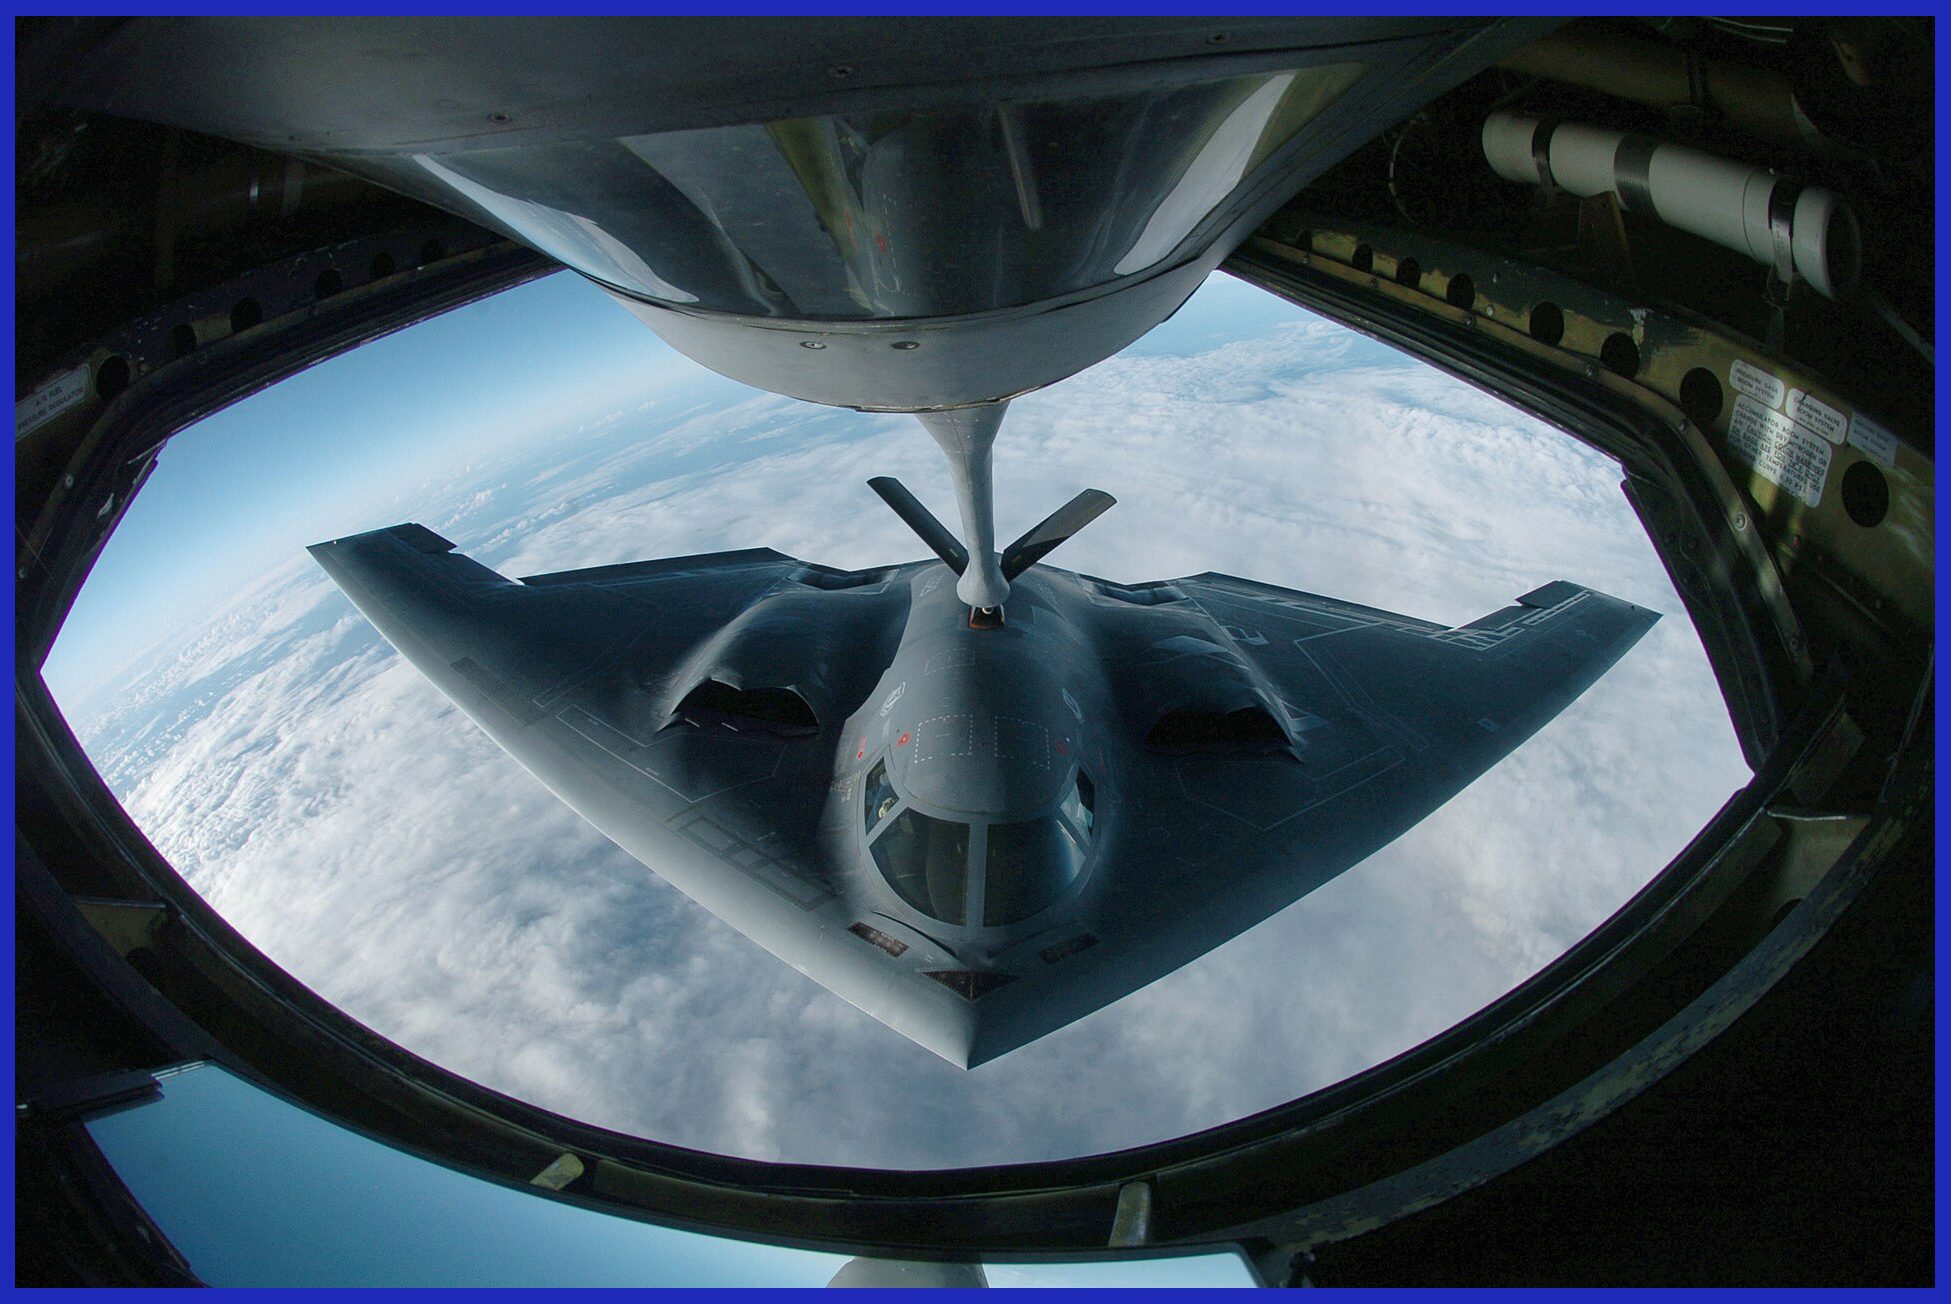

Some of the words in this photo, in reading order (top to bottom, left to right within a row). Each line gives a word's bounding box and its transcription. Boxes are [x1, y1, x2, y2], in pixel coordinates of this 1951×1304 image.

[1756, 386, 1774, 399] SYSTEM
[1794, 397, 1822, 416] CHARGING
[1824, 413, 1840, 426] VALVE
[1798, 408, 1814, 421] BOOM
[1815, 418, 1834, 432] SYSTEM
[1760, 424, 1773, 435] WITH
[1776, 432, 1787, 442] DRY
[1789, 440, 1817, 460] NITROGEN
[1783, 426, 1799, 439] BOOM
[1802, 436, 1824, 455] SYSTEM
[1766, 454, 1807, 484] TEMPERATURES
